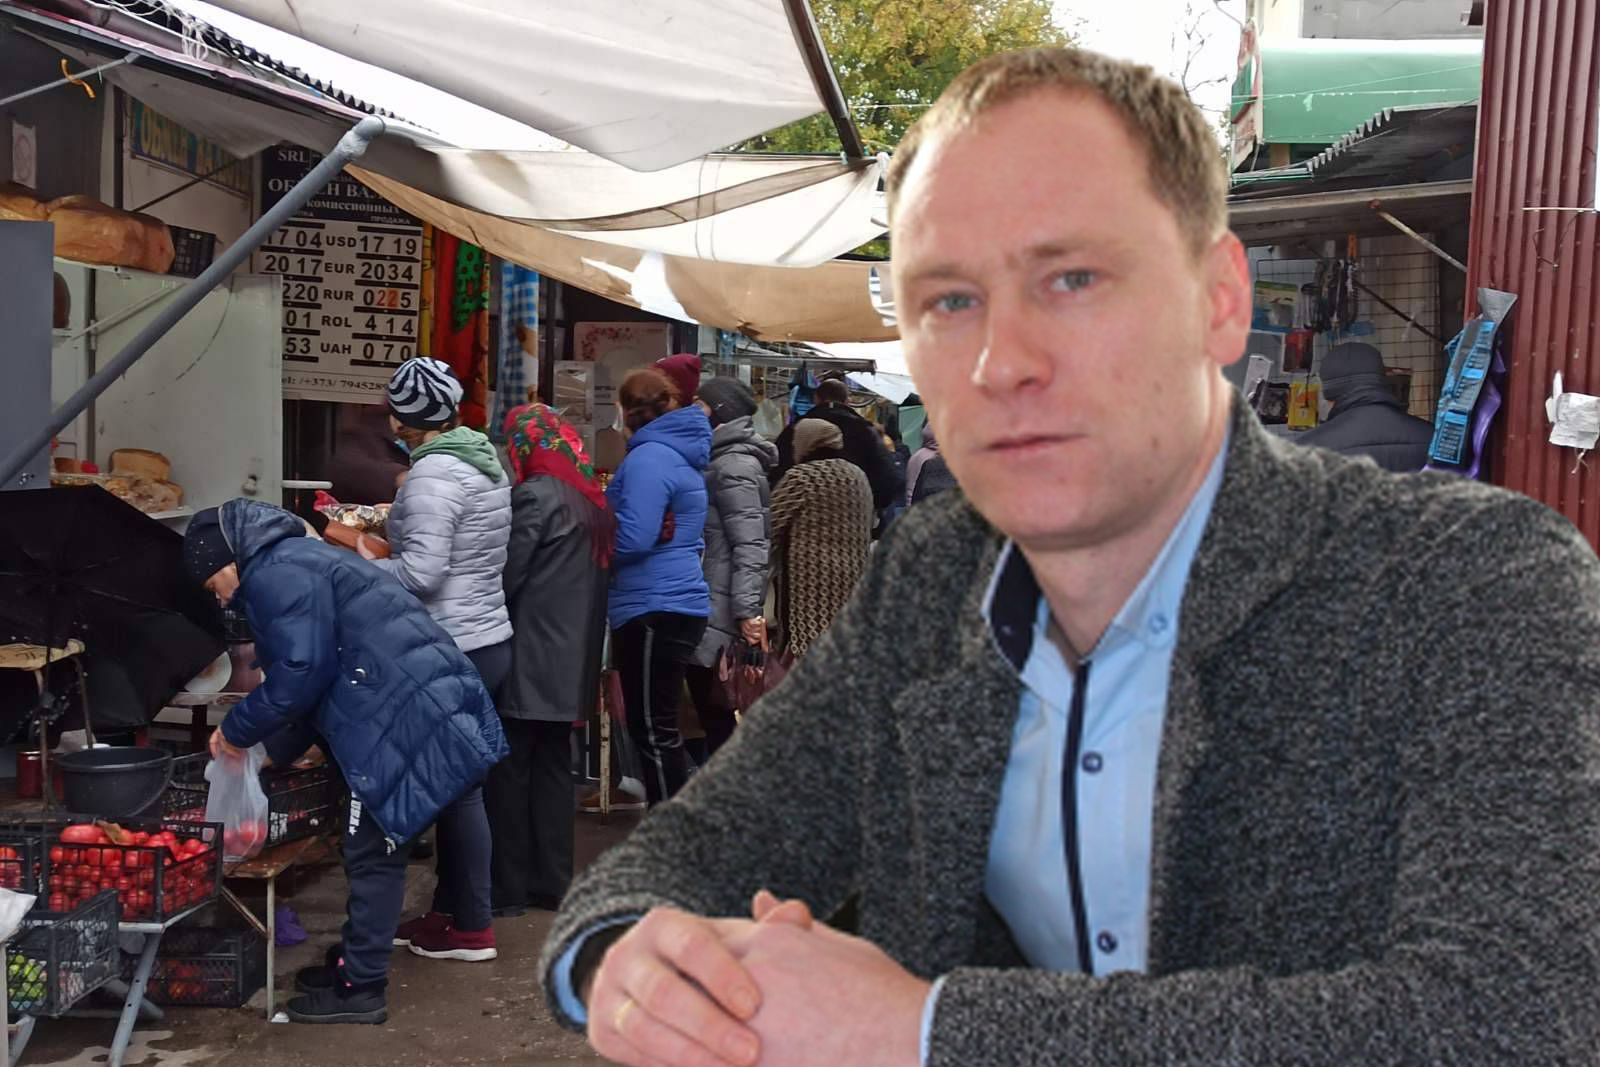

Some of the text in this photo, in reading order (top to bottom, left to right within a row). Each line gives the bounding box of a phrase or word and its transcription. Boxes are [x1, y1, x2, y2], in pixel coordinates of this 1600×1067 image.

[277, 149, 308, 163] SRL
[325, 235, 357, 248] USD
[324, 262, 355, 274] EUR
[360, 261, 414, 282] 2034
[323, 288, 354, 301] RUR
[362, 289, 412, 309] 0225
[321, 315, 352, 328] ROL
[320, 342, 352, 355] UAH
